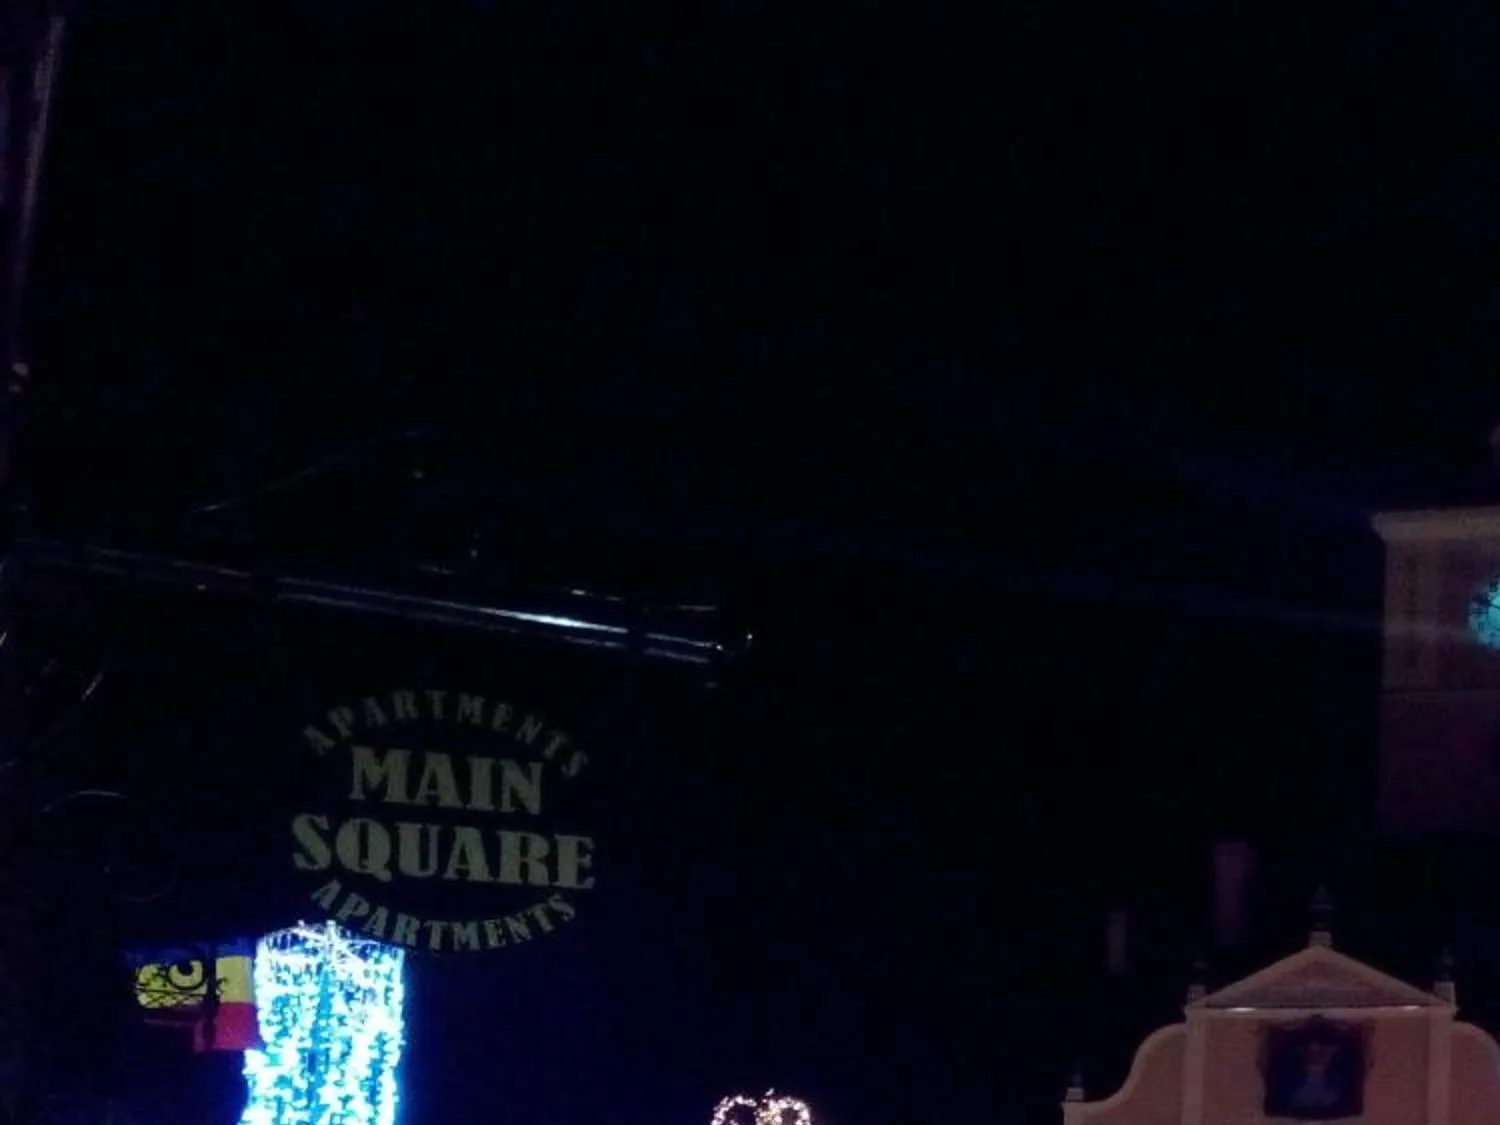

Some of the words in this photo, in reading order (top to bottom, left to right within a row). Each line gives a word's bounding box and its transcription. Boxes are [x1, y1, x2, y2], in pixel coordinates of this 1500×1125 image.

[301, 688, 590, 779] APARTMENTS
[347, 744, 544, 815] MAIN
[290, 811, 597, 889] SQUARE
[309, 879, 576, 952] APARTMENTS
